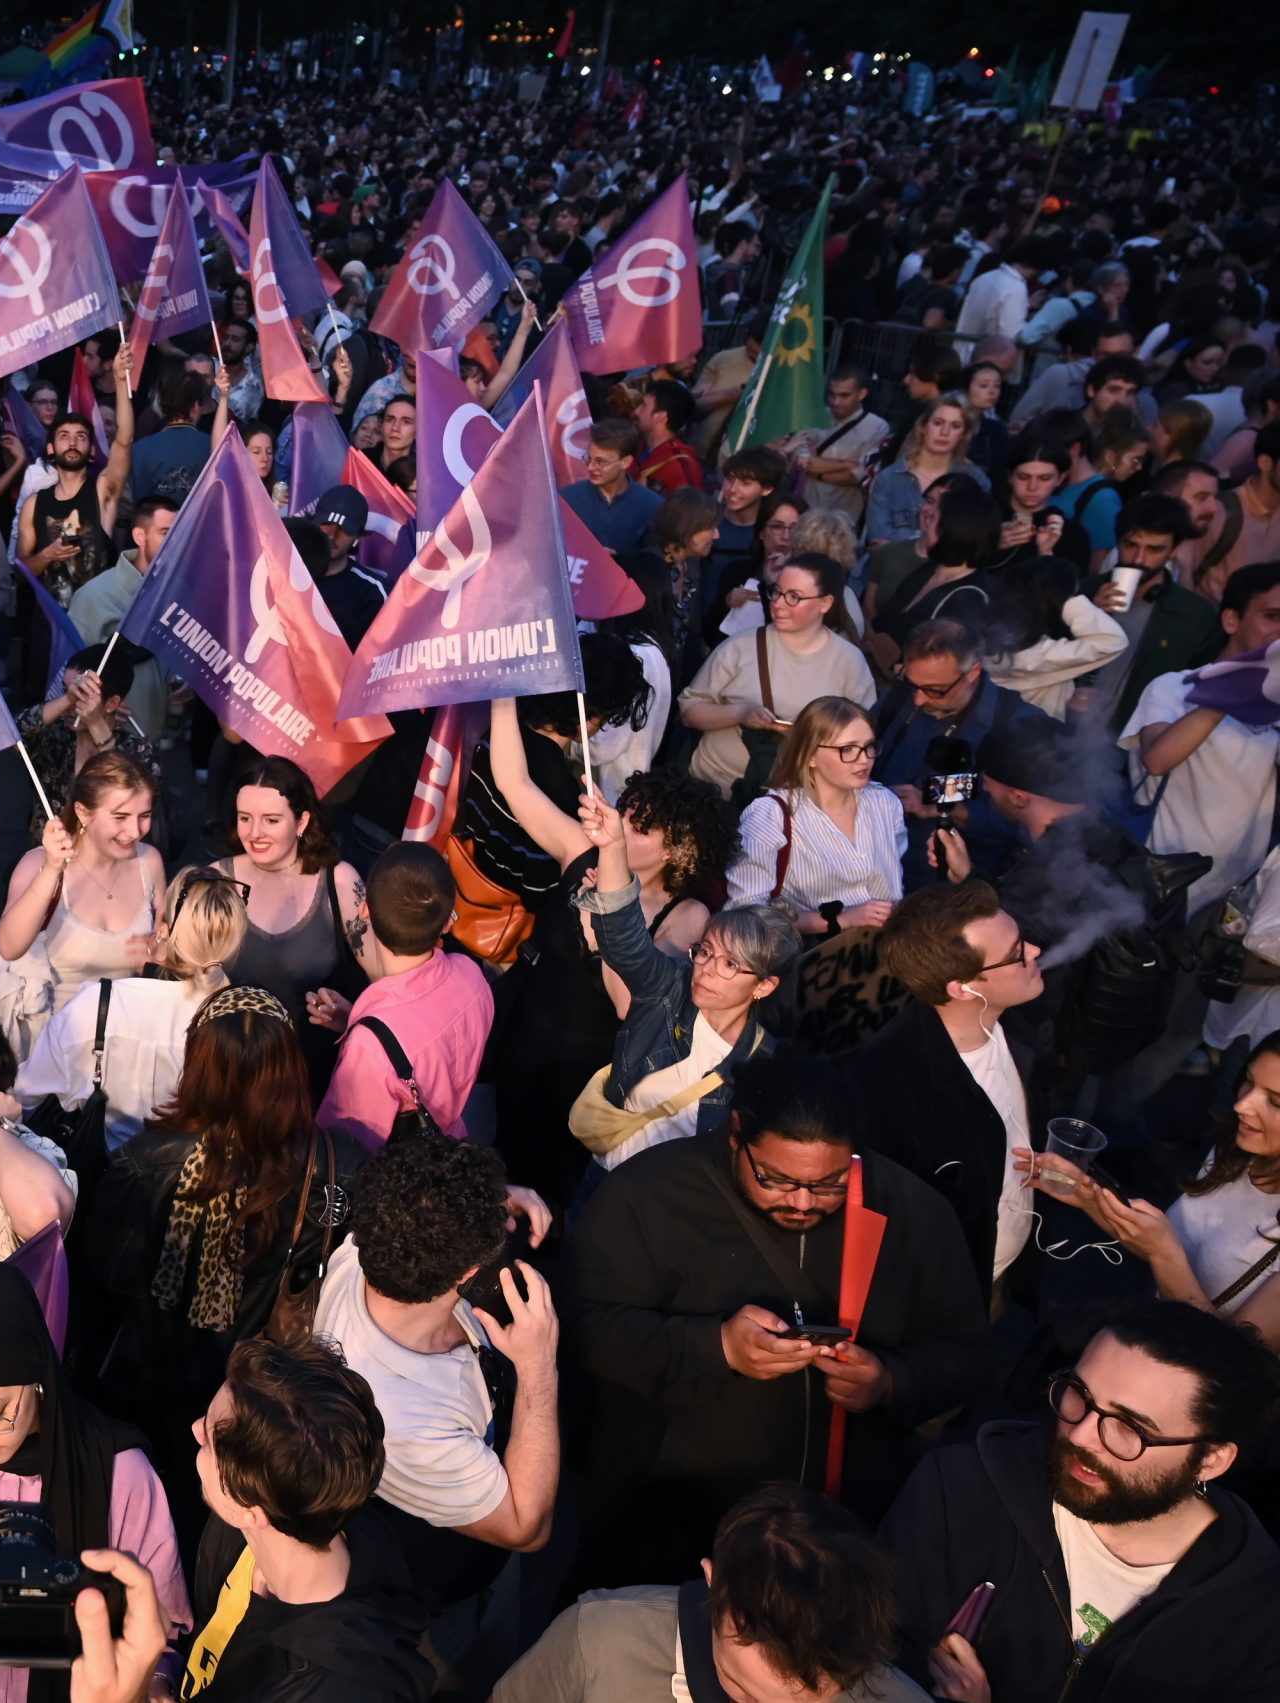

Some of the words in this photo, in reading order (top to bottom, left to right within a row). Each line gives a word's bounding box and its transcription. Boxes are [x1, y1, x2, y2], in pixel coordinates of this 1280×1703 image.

[579, 282, 605, 345] POPULAIRE
[160, 601, 234, 675] L'UNION
[222, 662, 316, 747] POPULAIRE
